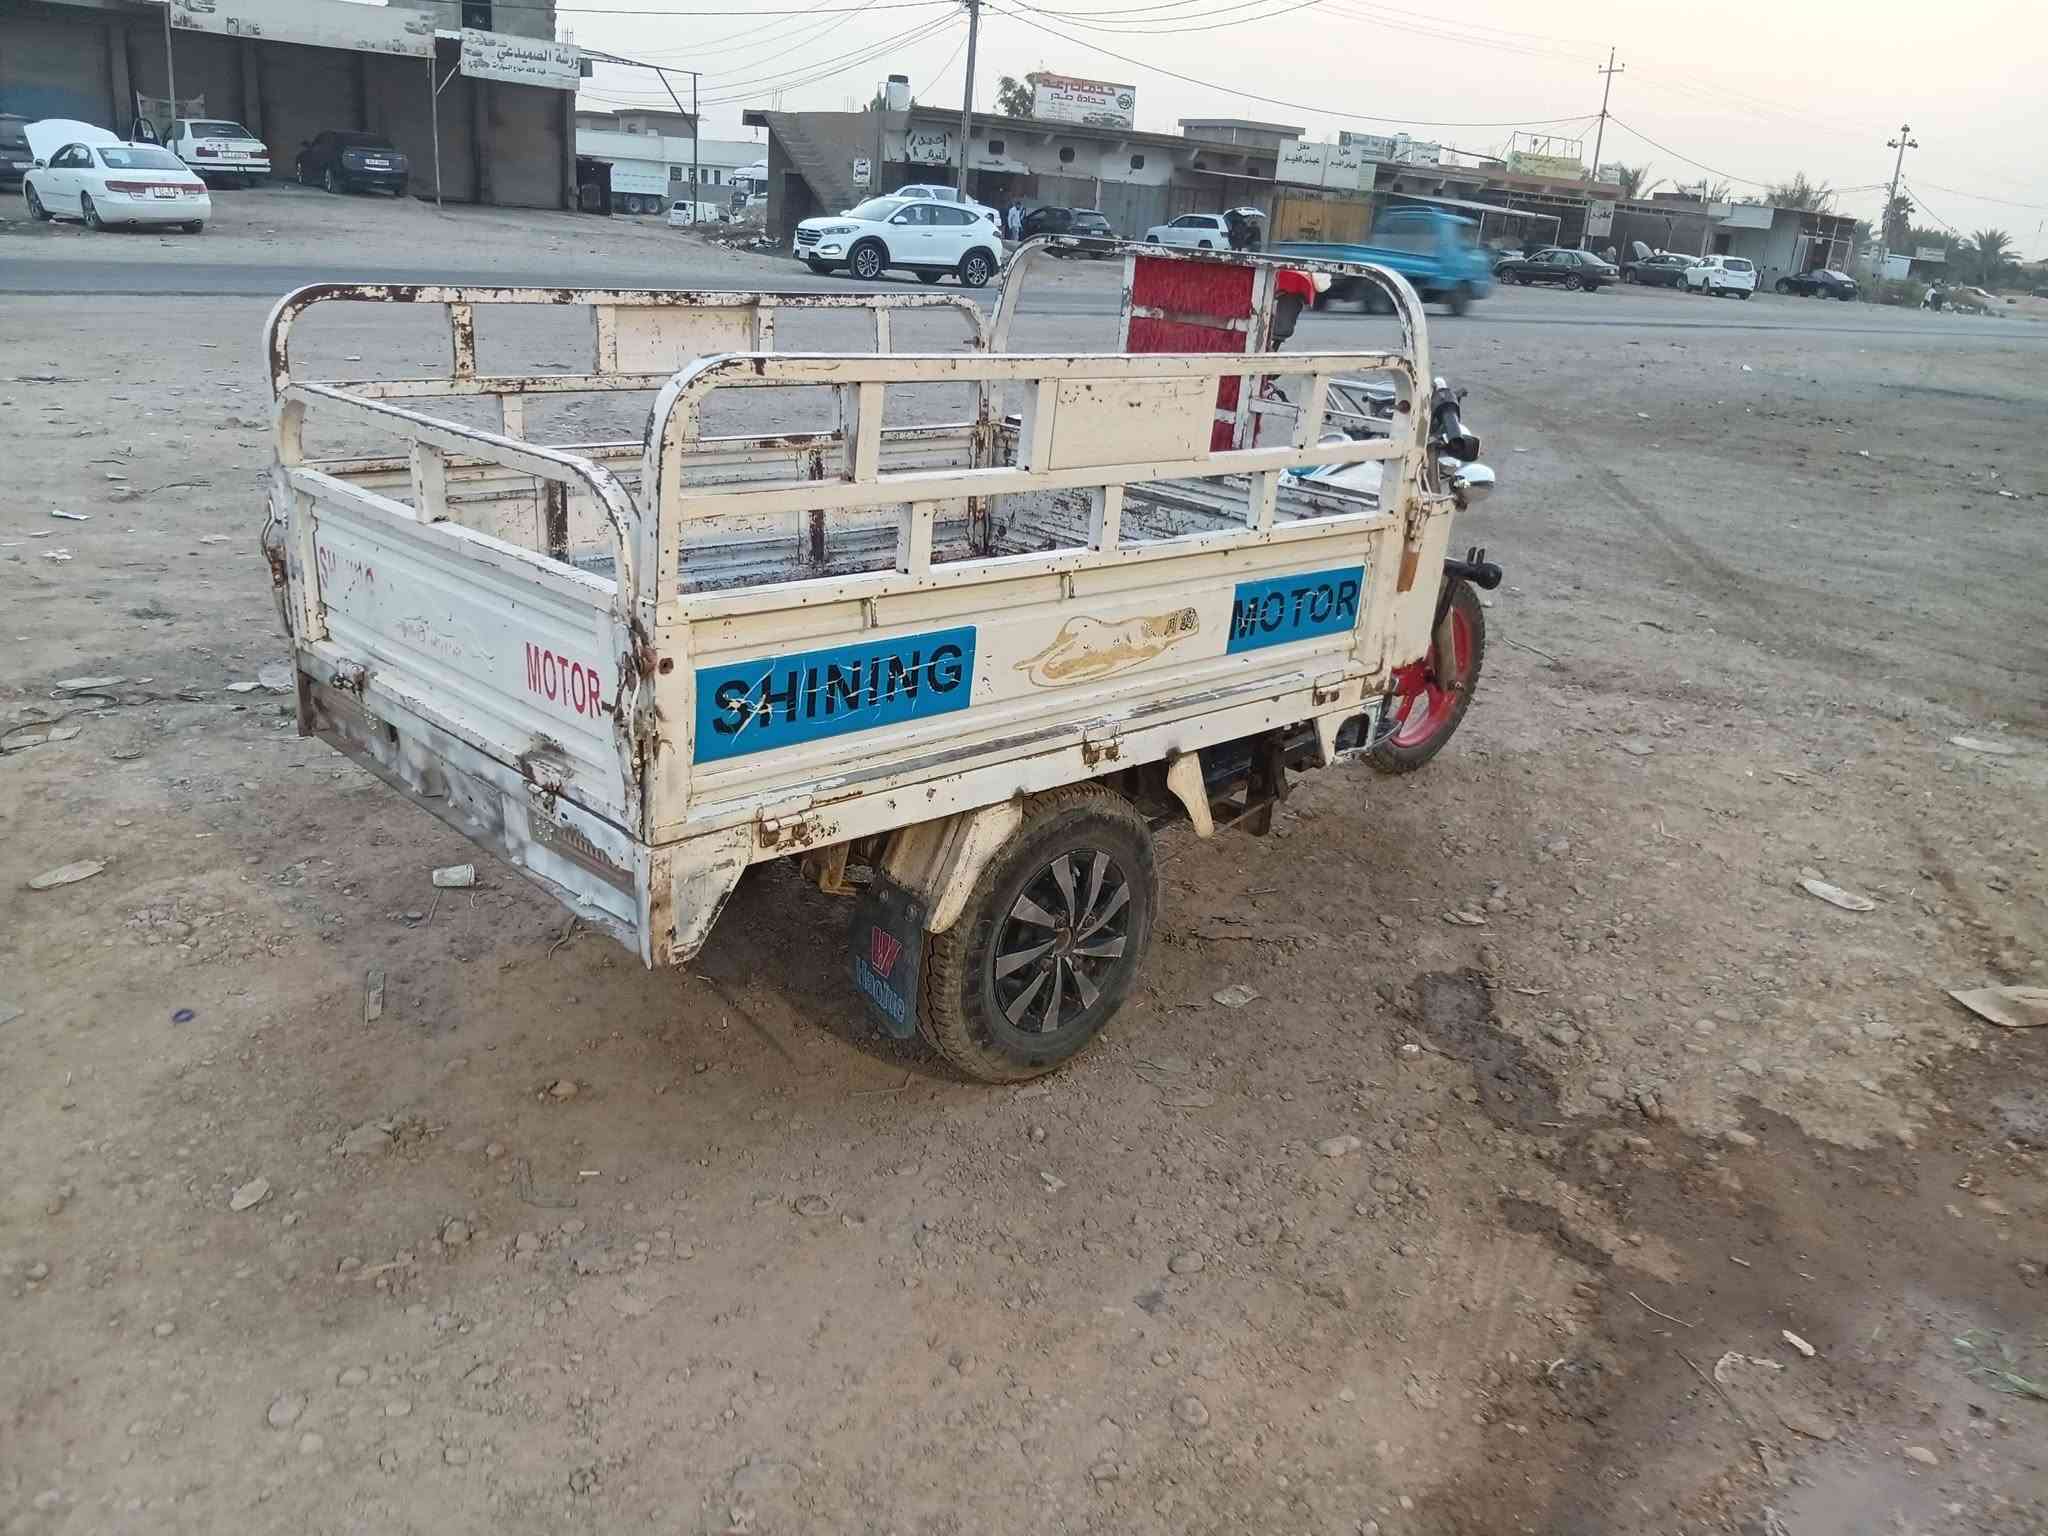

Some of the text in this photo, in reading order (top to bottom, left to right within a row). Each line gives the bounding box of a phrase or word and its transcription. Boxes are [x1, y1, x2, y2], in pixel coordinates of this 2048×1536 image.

[1229, 579, 1359, 641] MOTOR
[525, 641, 602, 719] MOTOR
[712, 644, 963, 736] SHINING
